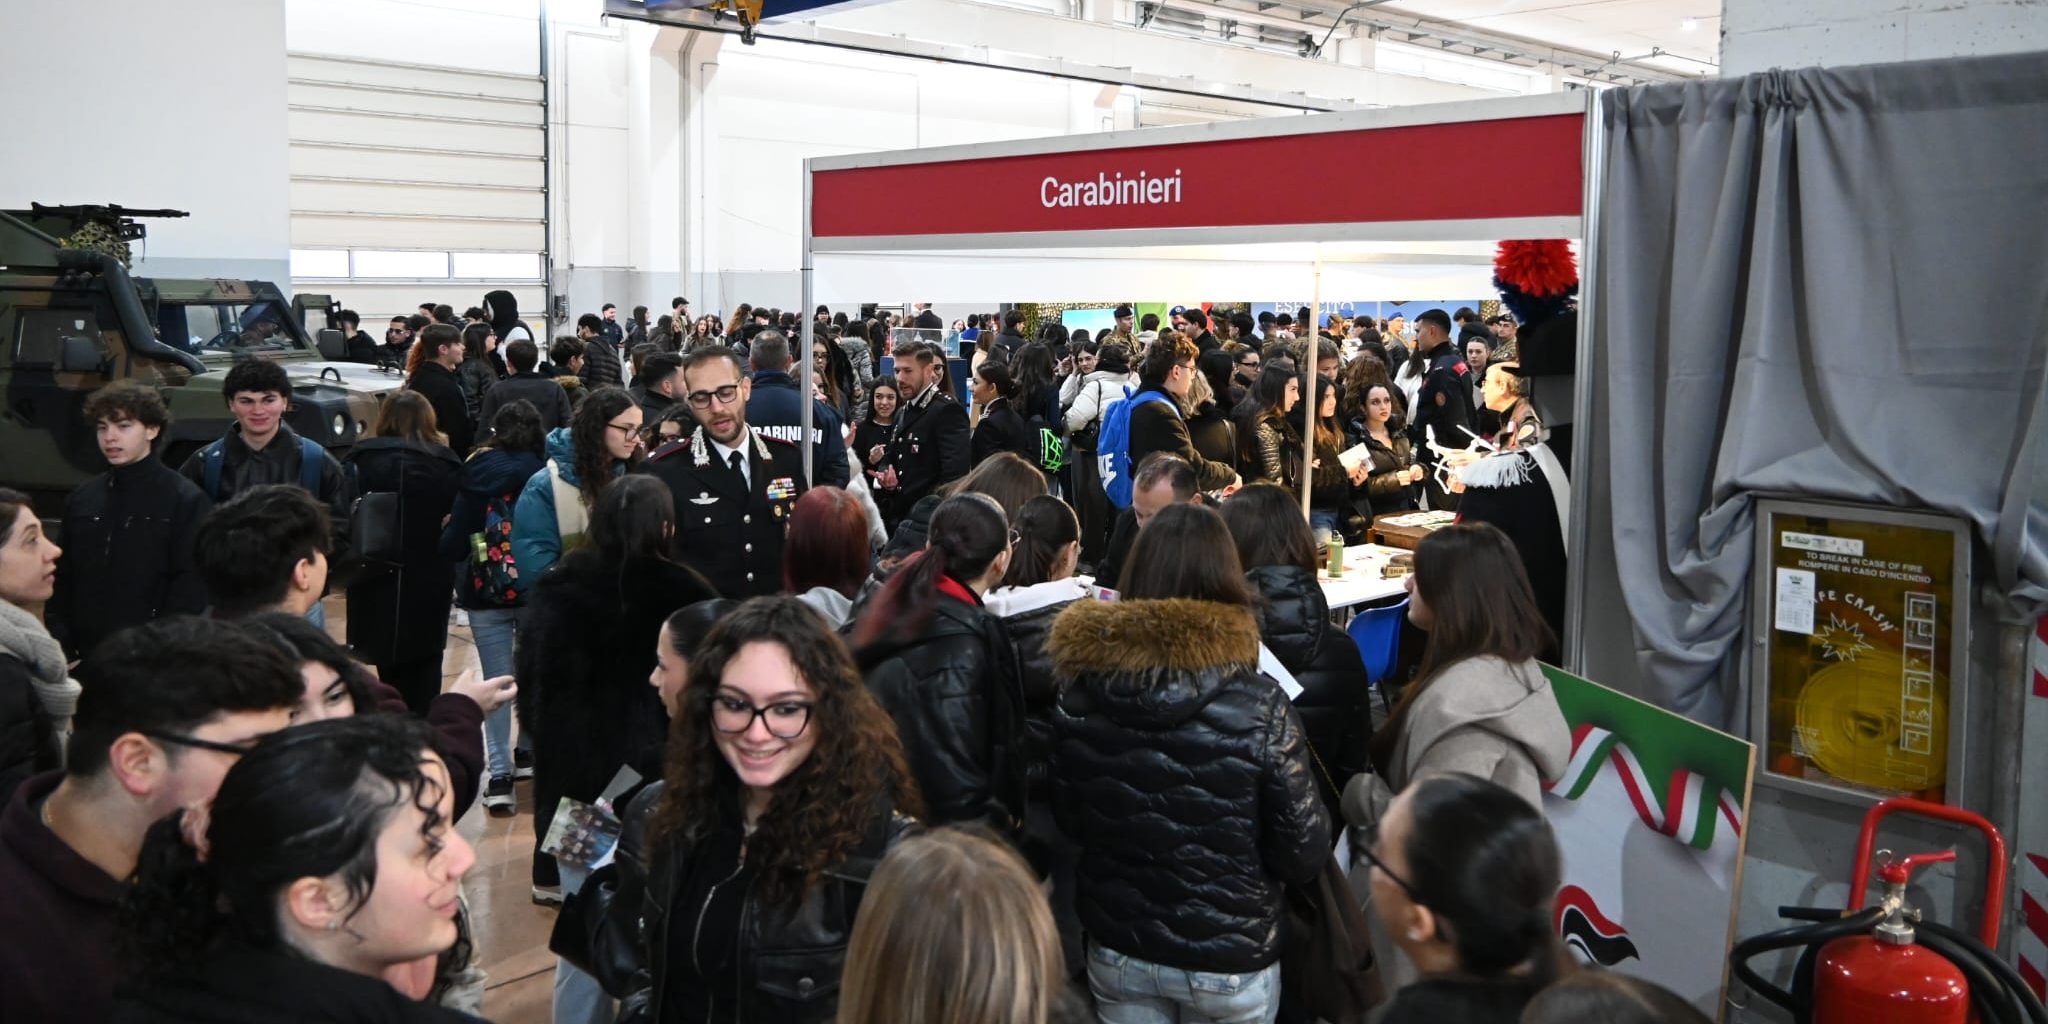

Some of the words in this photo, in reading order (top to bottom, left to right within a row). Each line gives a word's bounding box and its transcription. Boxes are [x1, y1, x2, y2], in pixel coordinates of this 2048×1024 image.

[1040, 168, 1182, 208] Carabinieri
[1798, 559, 1840, 571] ROMPERE
[1841, 564, 1851, 573] IN
[1852, 566, 1878, 577] CASO
[1806, 551, 1818, 560] TO
[1819, 552, 1849, 563] BREAK
[1850, 556, 1860, 565] IN
[1861, 558, 1886, 569] CASE
[1844, 592, 1895, 632] CRASH
